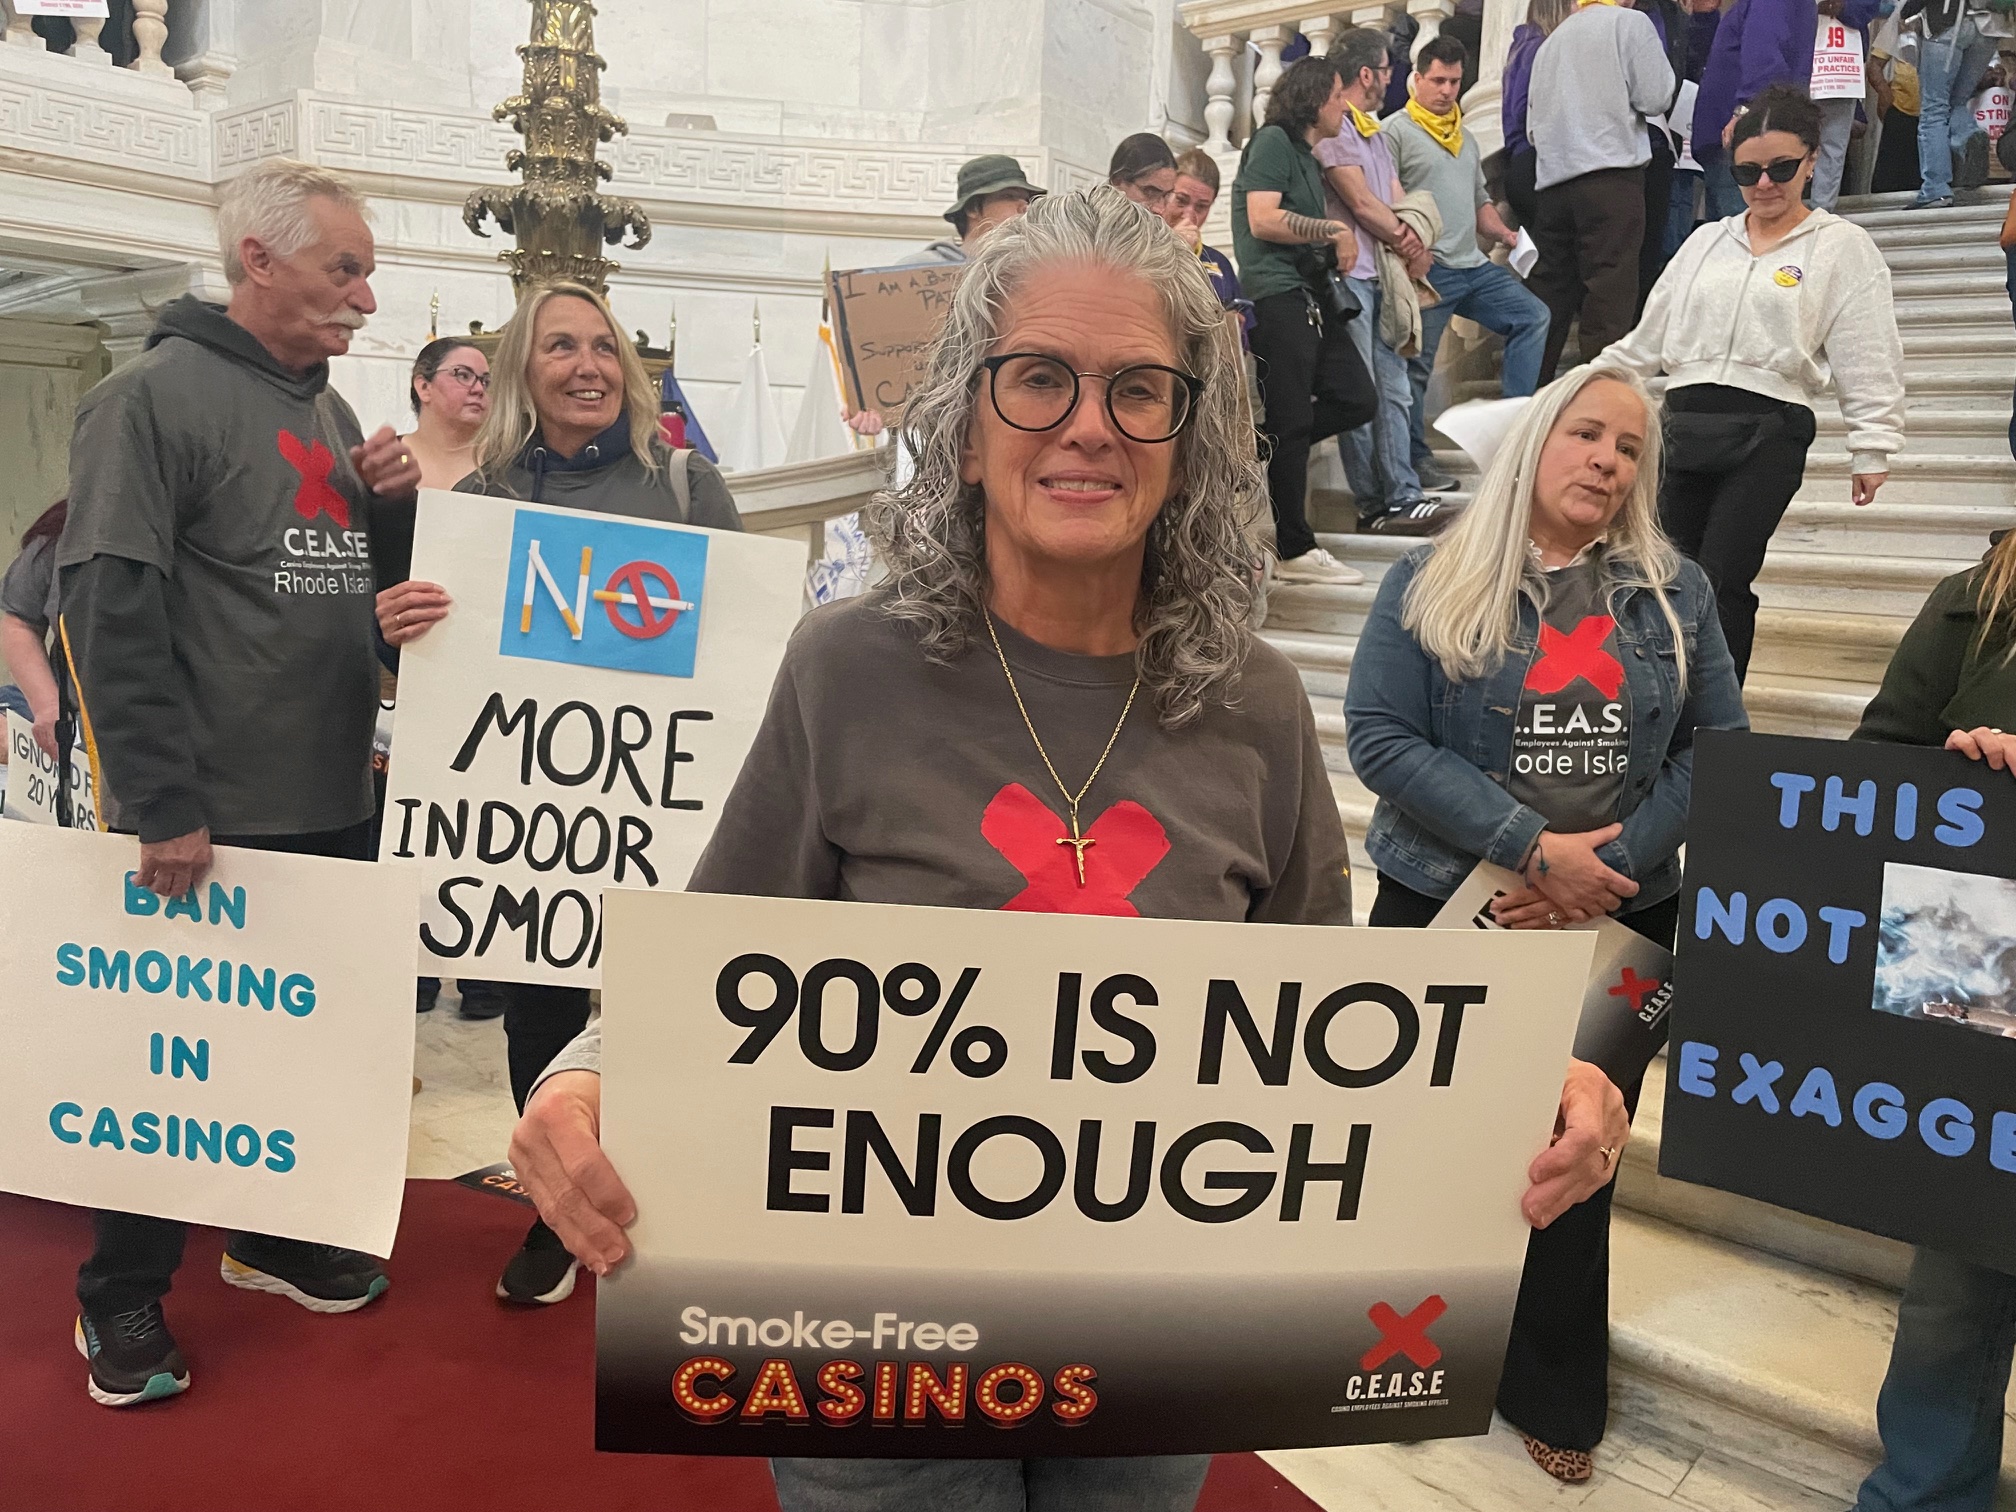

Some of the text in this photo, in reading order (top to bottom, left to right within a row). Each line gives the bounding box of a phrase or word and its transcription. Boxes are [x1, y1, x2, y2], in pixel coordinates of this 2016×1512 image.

[1817, 65, 1860, 73] PRACTICES
[1992, 94, 2009, 106] ON
[878, 282, 902, 296] AM
[274, 571, 374, 595] Rhode Islan
[449, 691, 714, 810] MORE
[1515, 738, 1560, 749] Employees
[1562, 738, 1594, 749] Against
[1584, 749, 1628, 776] Isla
[27, 773, 44, 806] 20
[1770, 771, 1986, 848] THIS
[392, 798, 659, 887] INDOOR
[124, 869, 247, 930] BAN
[419, 876, 603, 970] SMO
[1695, 886, 1867, 965] NOT
[56, 942, 317, 1018] SMOKING
[715, 952, 1488, 1089] 90% IS NOT
[149, 1032, 210, 1082] IN
[49, 1101, 297, 1174] CASINOS
[766, 1105, 1372, 1224] ENOUGH
[679, 1305, 980, 1352] Smoke-Free
[671, 1355, 1100, 1427] CASINOS
[1345, 1369, 1445, 1401] C.E.A.S.E
